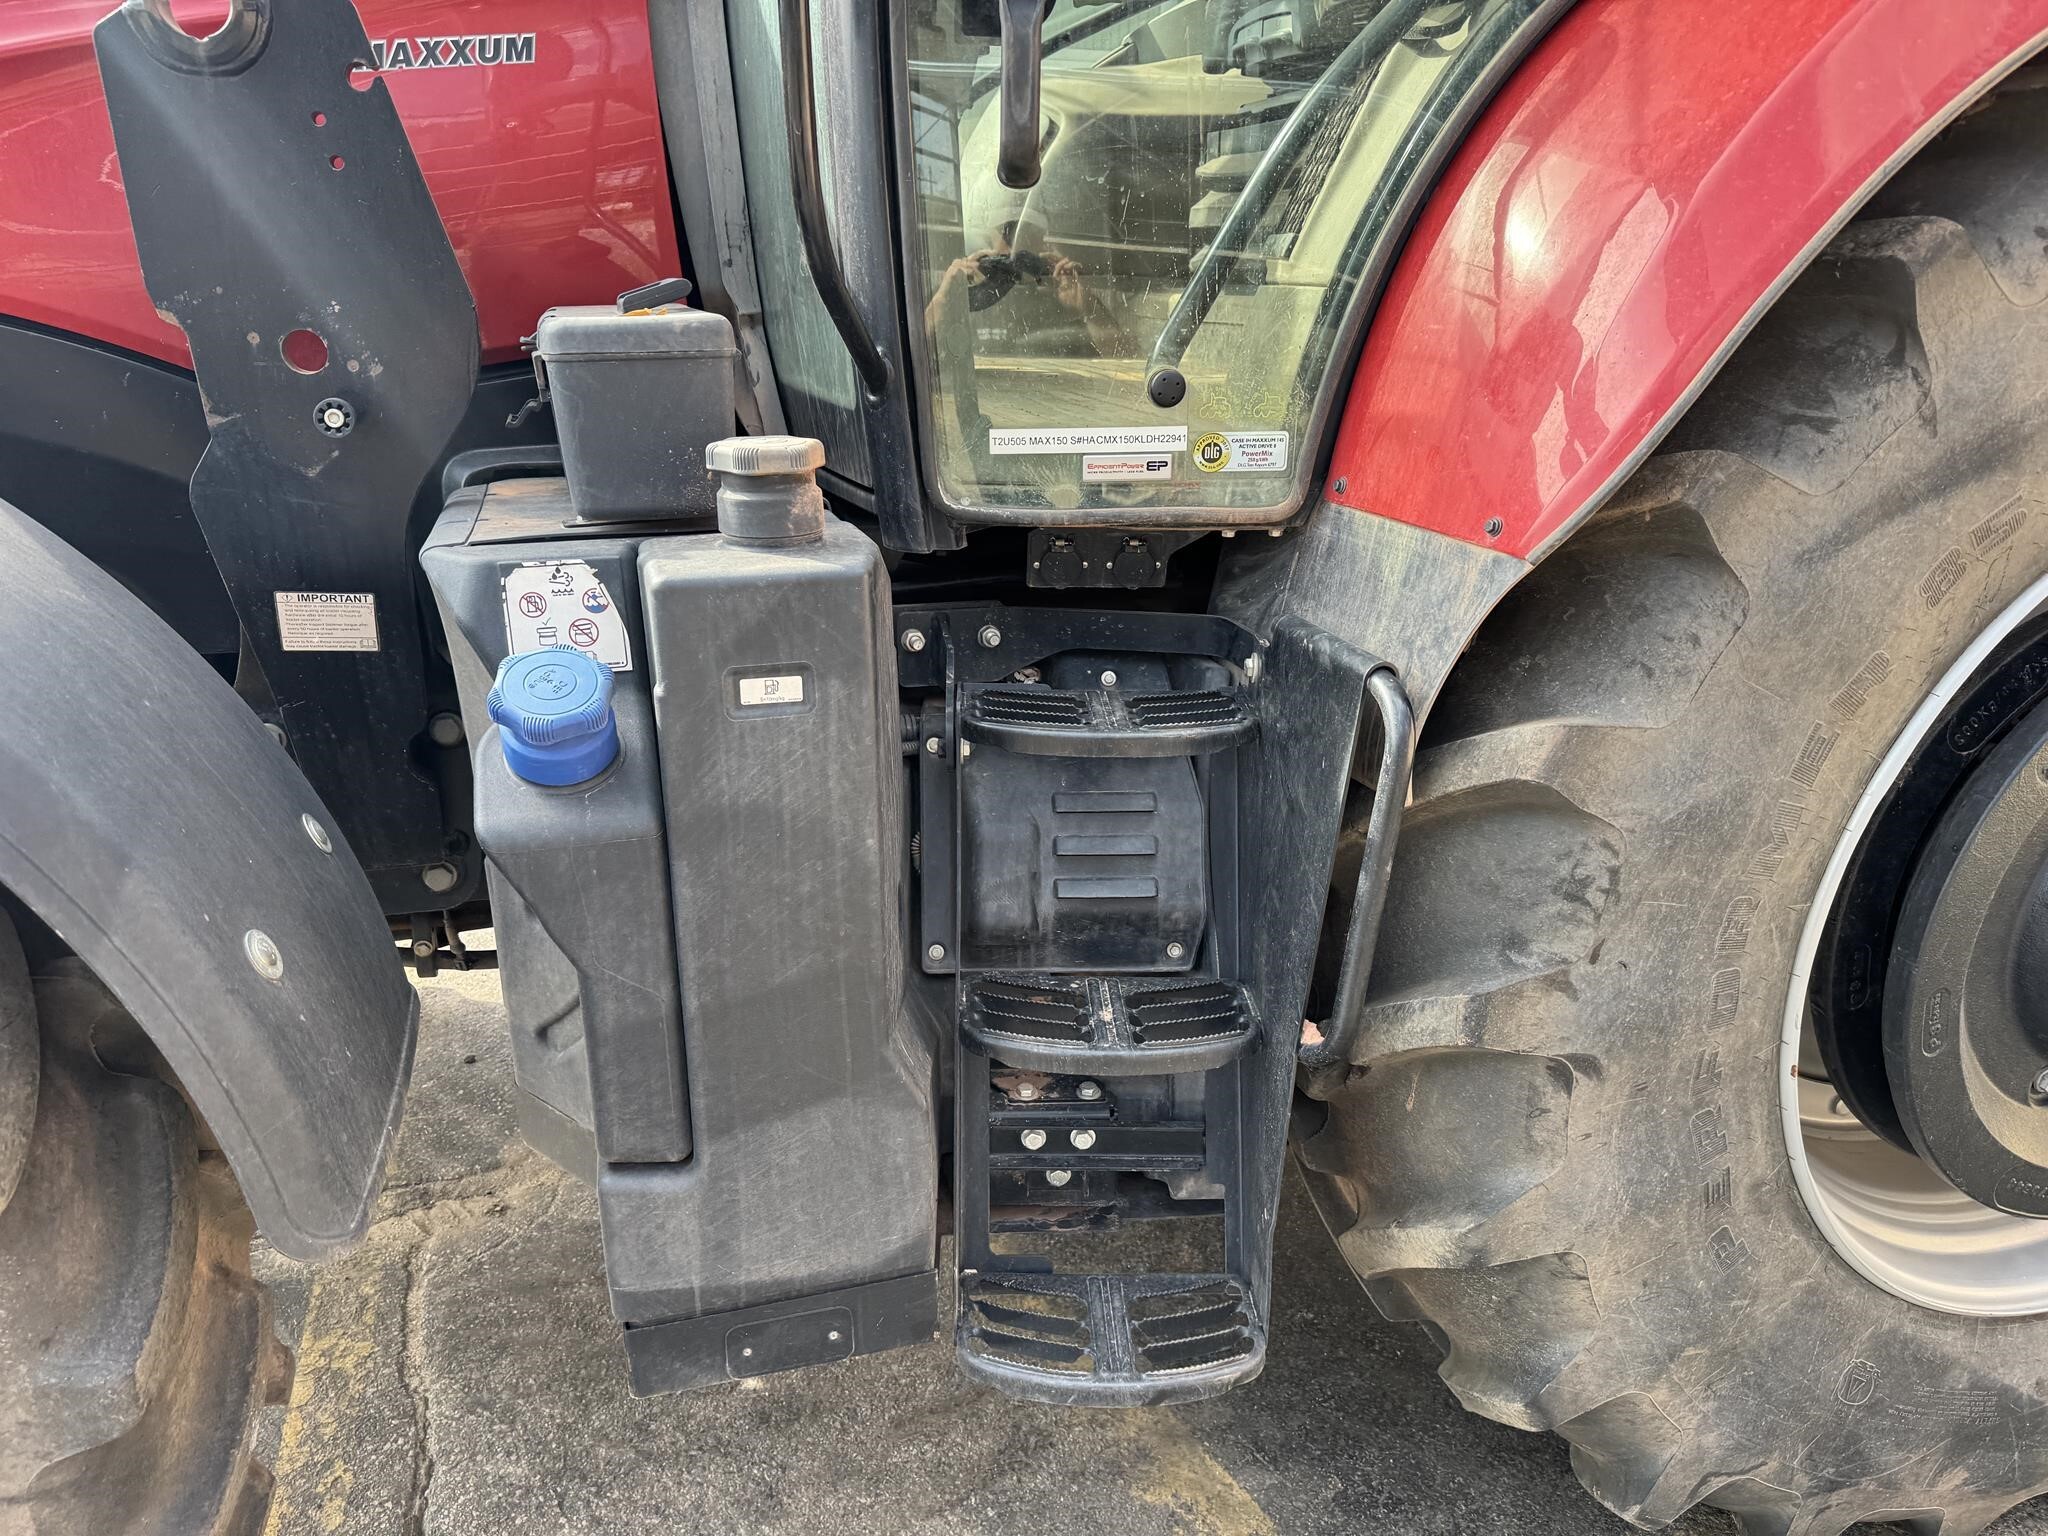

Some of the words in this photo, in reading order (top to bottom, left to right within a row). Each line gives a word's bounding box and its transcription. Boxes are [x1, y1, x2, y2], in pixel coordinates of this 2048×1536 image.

[991, 437, 1027, 446] T2U505
[1029, 436, 1068, 446] MAX150
[1070, 434, 1187, 445] S#HACMX150KLDH22941
[1204, 442, 1220, 459] DLG
[1146, 460, 1169, 472] EP
[1917, 489, 2029, 612] 85
[297, 594, 370, 603] IMPORTANT
